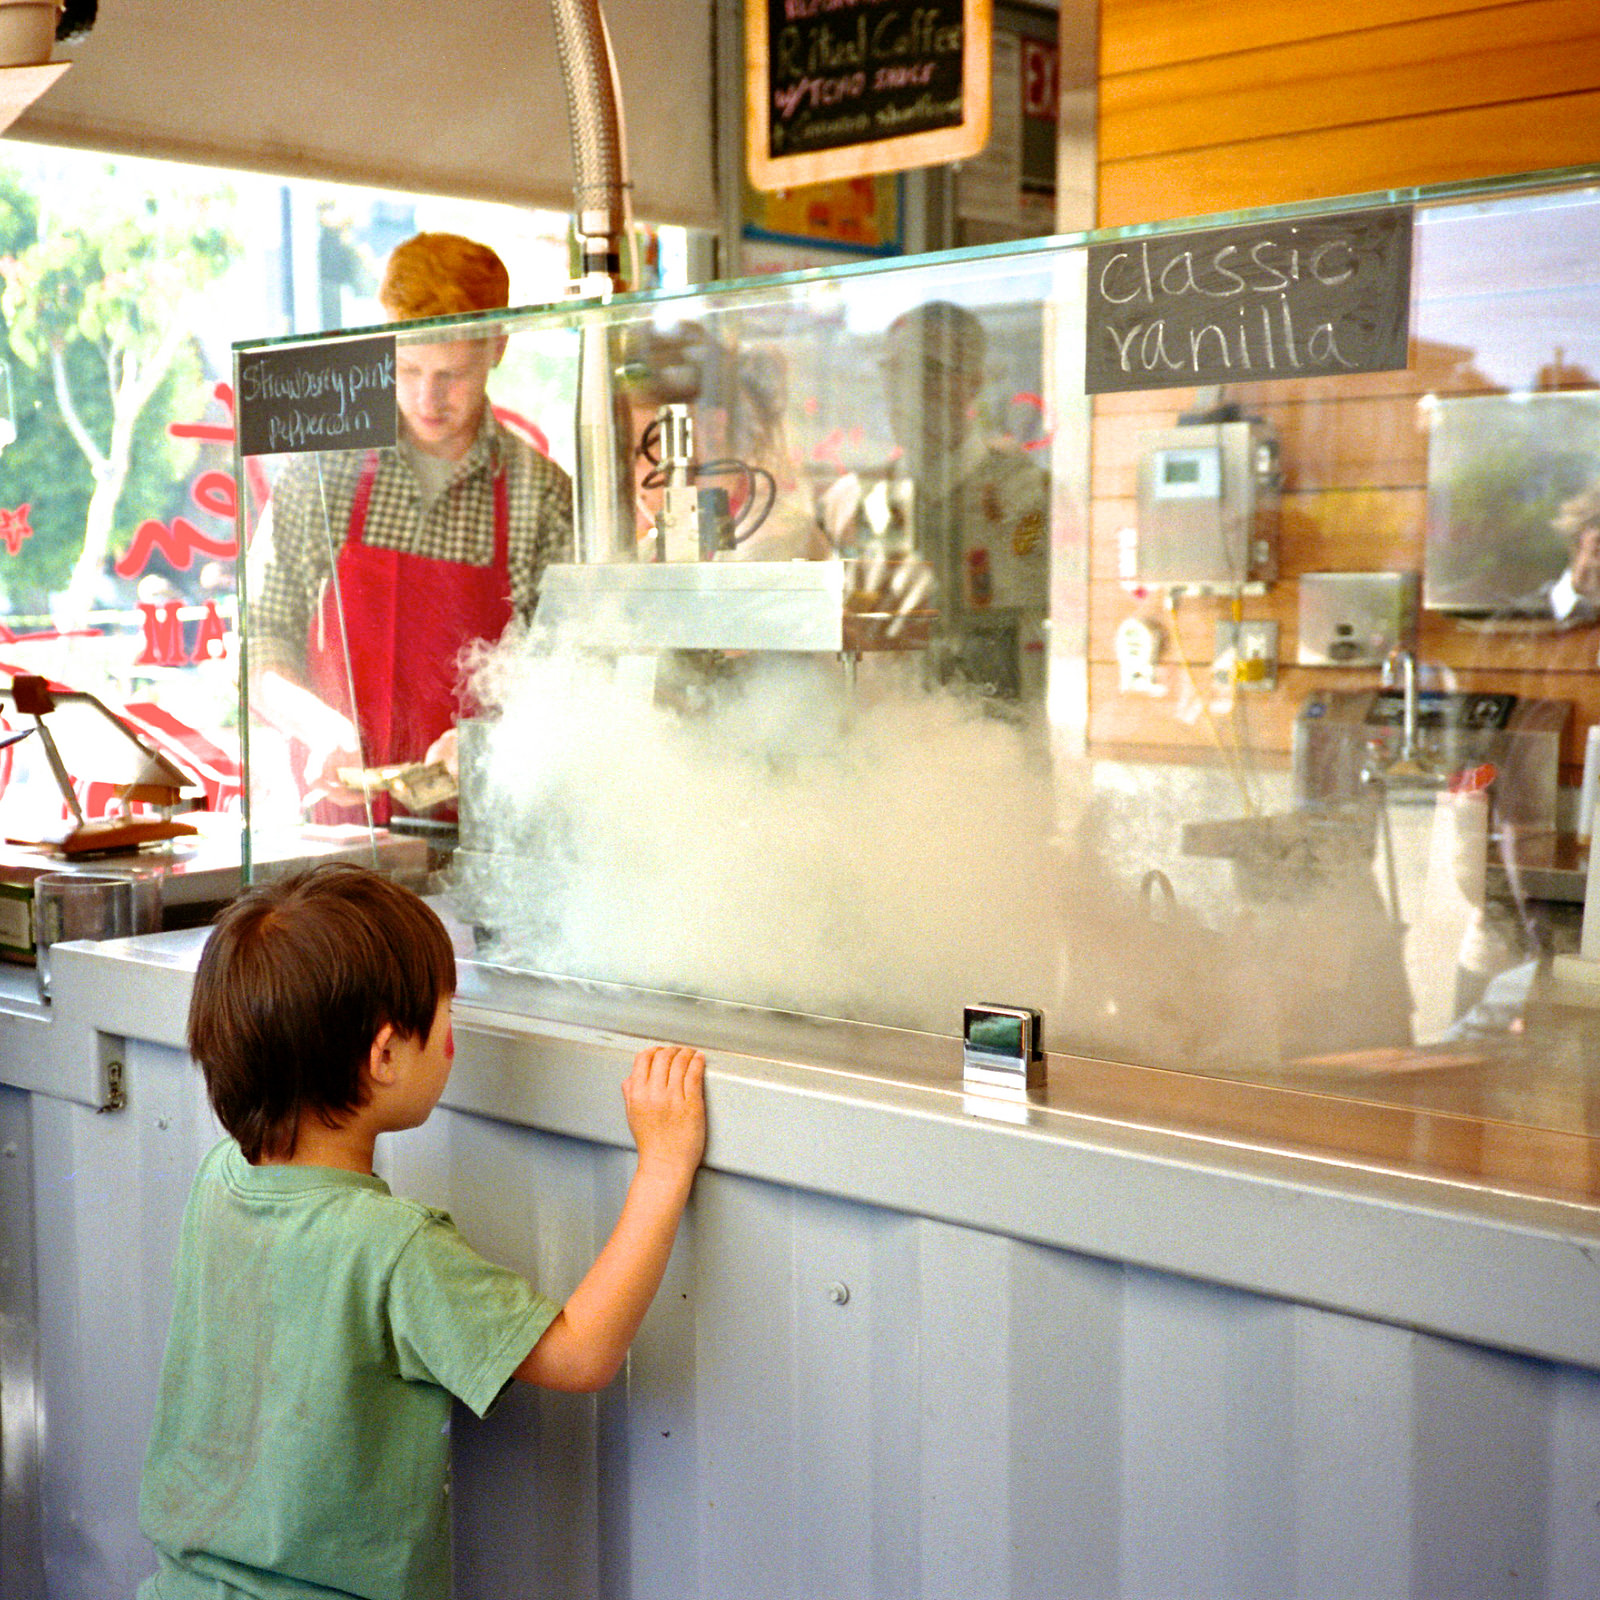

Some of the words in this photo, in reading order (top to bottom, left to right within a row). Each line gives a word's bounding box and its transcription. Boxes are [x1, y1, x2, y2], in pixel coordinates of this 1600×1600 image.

[1100, 227, 1356, 304] classic
[1105, 293, 1359, 372] vanilla
[349, 353, 396, 403] pink
